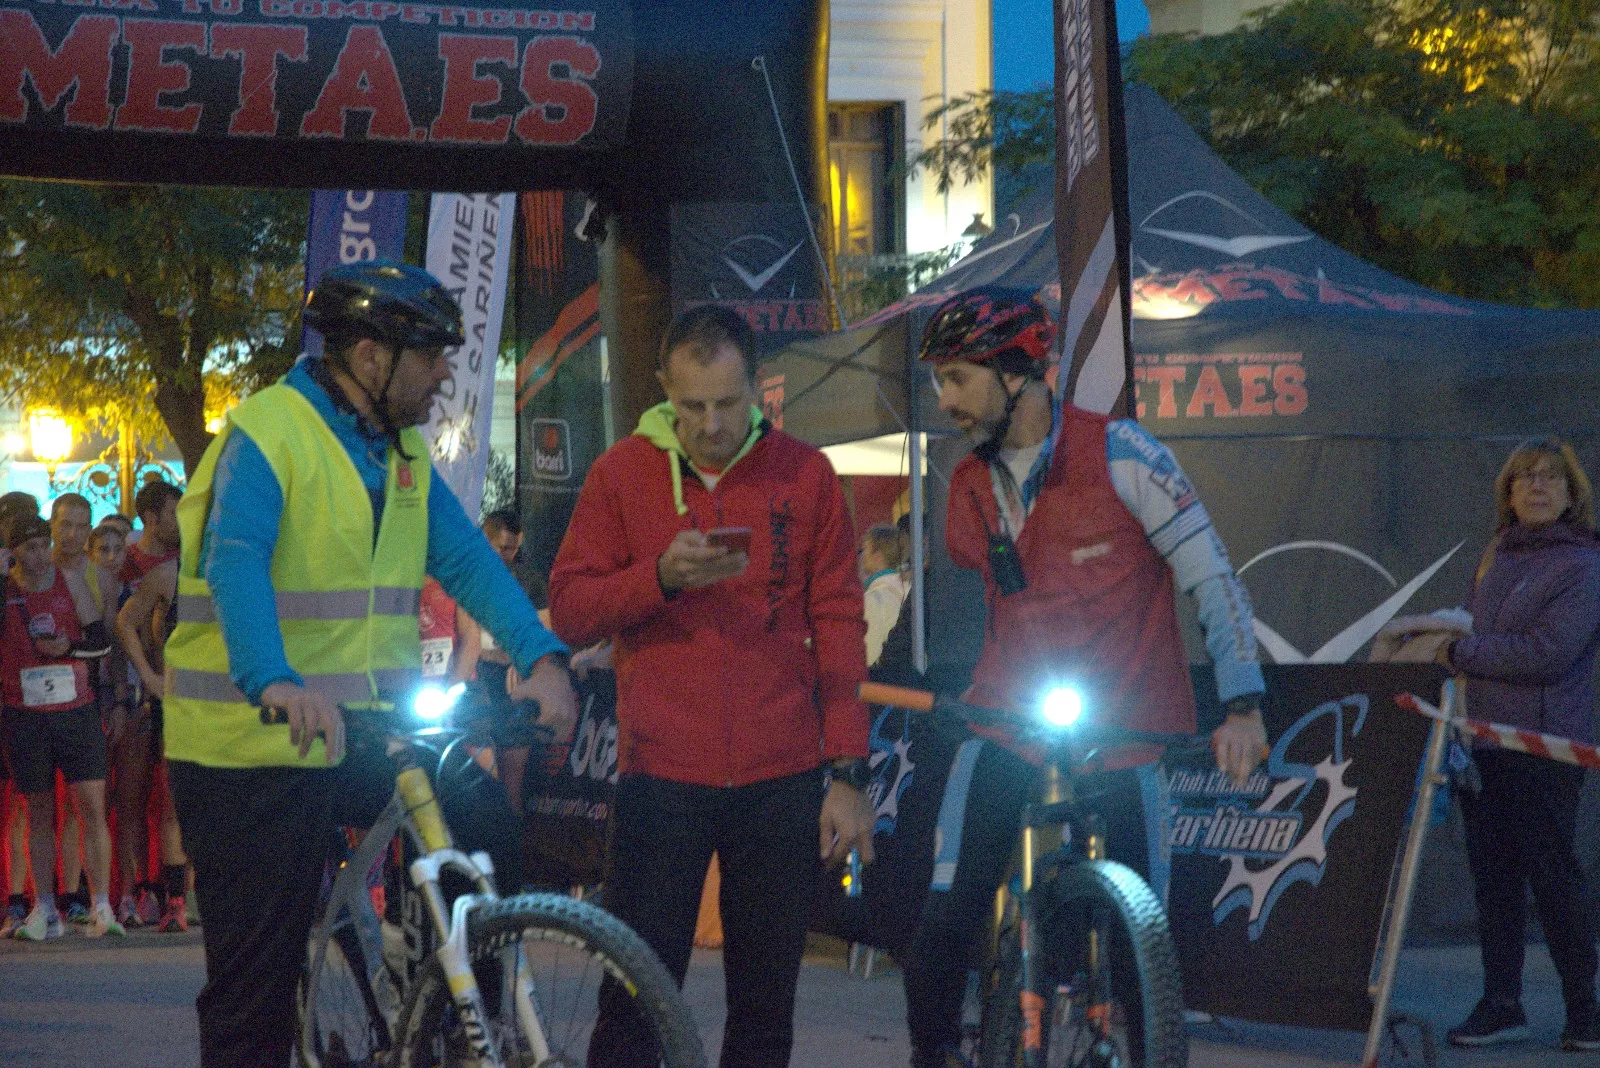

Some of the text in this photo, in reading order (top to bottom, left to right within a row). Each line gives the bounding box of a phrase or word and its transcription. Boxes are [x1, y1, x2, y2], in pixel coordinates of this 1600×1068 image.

[260, 0, 597, 31] COMPETICION
[423, 651, 445, 665] 23
[44, 678, 55, 693] 5
[1166, 803, 1300, 852] ariñena
